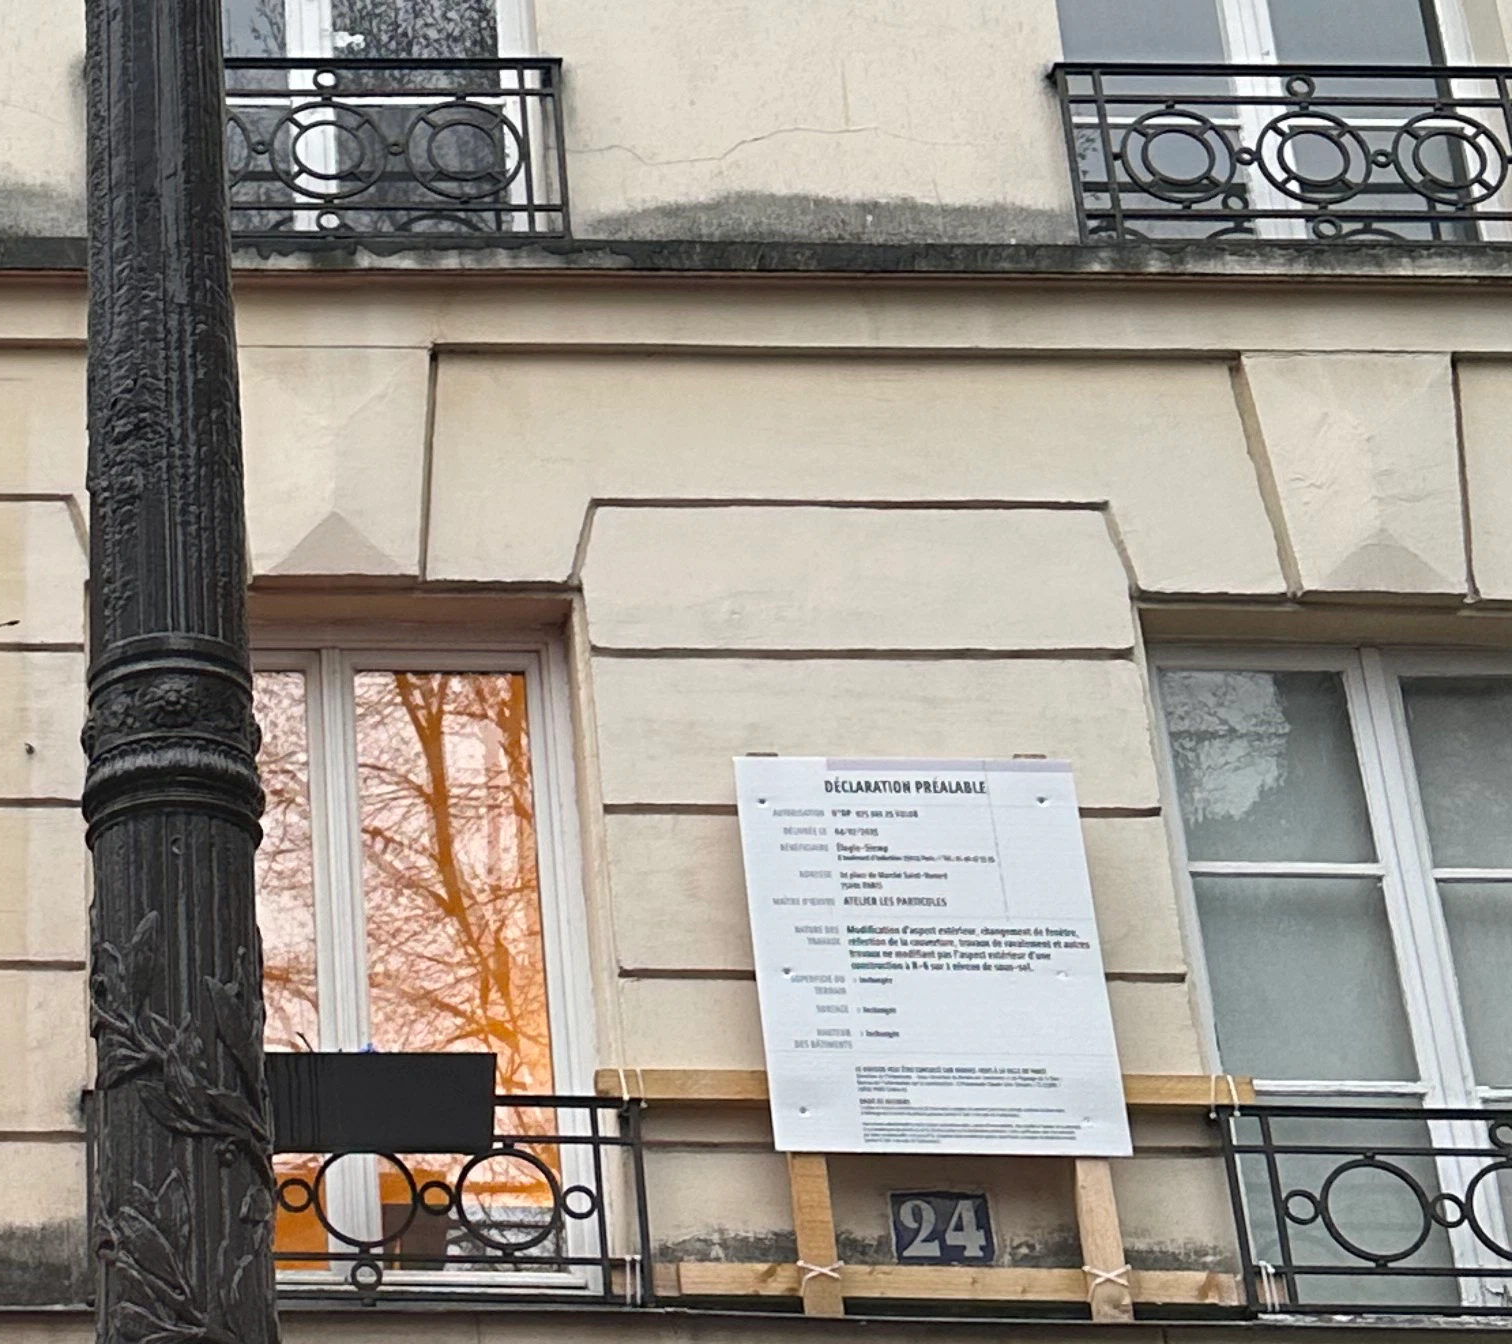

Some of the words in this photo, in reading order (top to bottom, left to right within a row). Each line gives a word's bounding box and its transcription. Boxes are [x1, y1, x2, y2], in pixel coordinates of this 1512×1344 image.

[824, 776, 911, 794] DÉCLARATION
[915, 776, 986, 794] PRÉALABLE
[899, 1199, 987, 1257] 24
